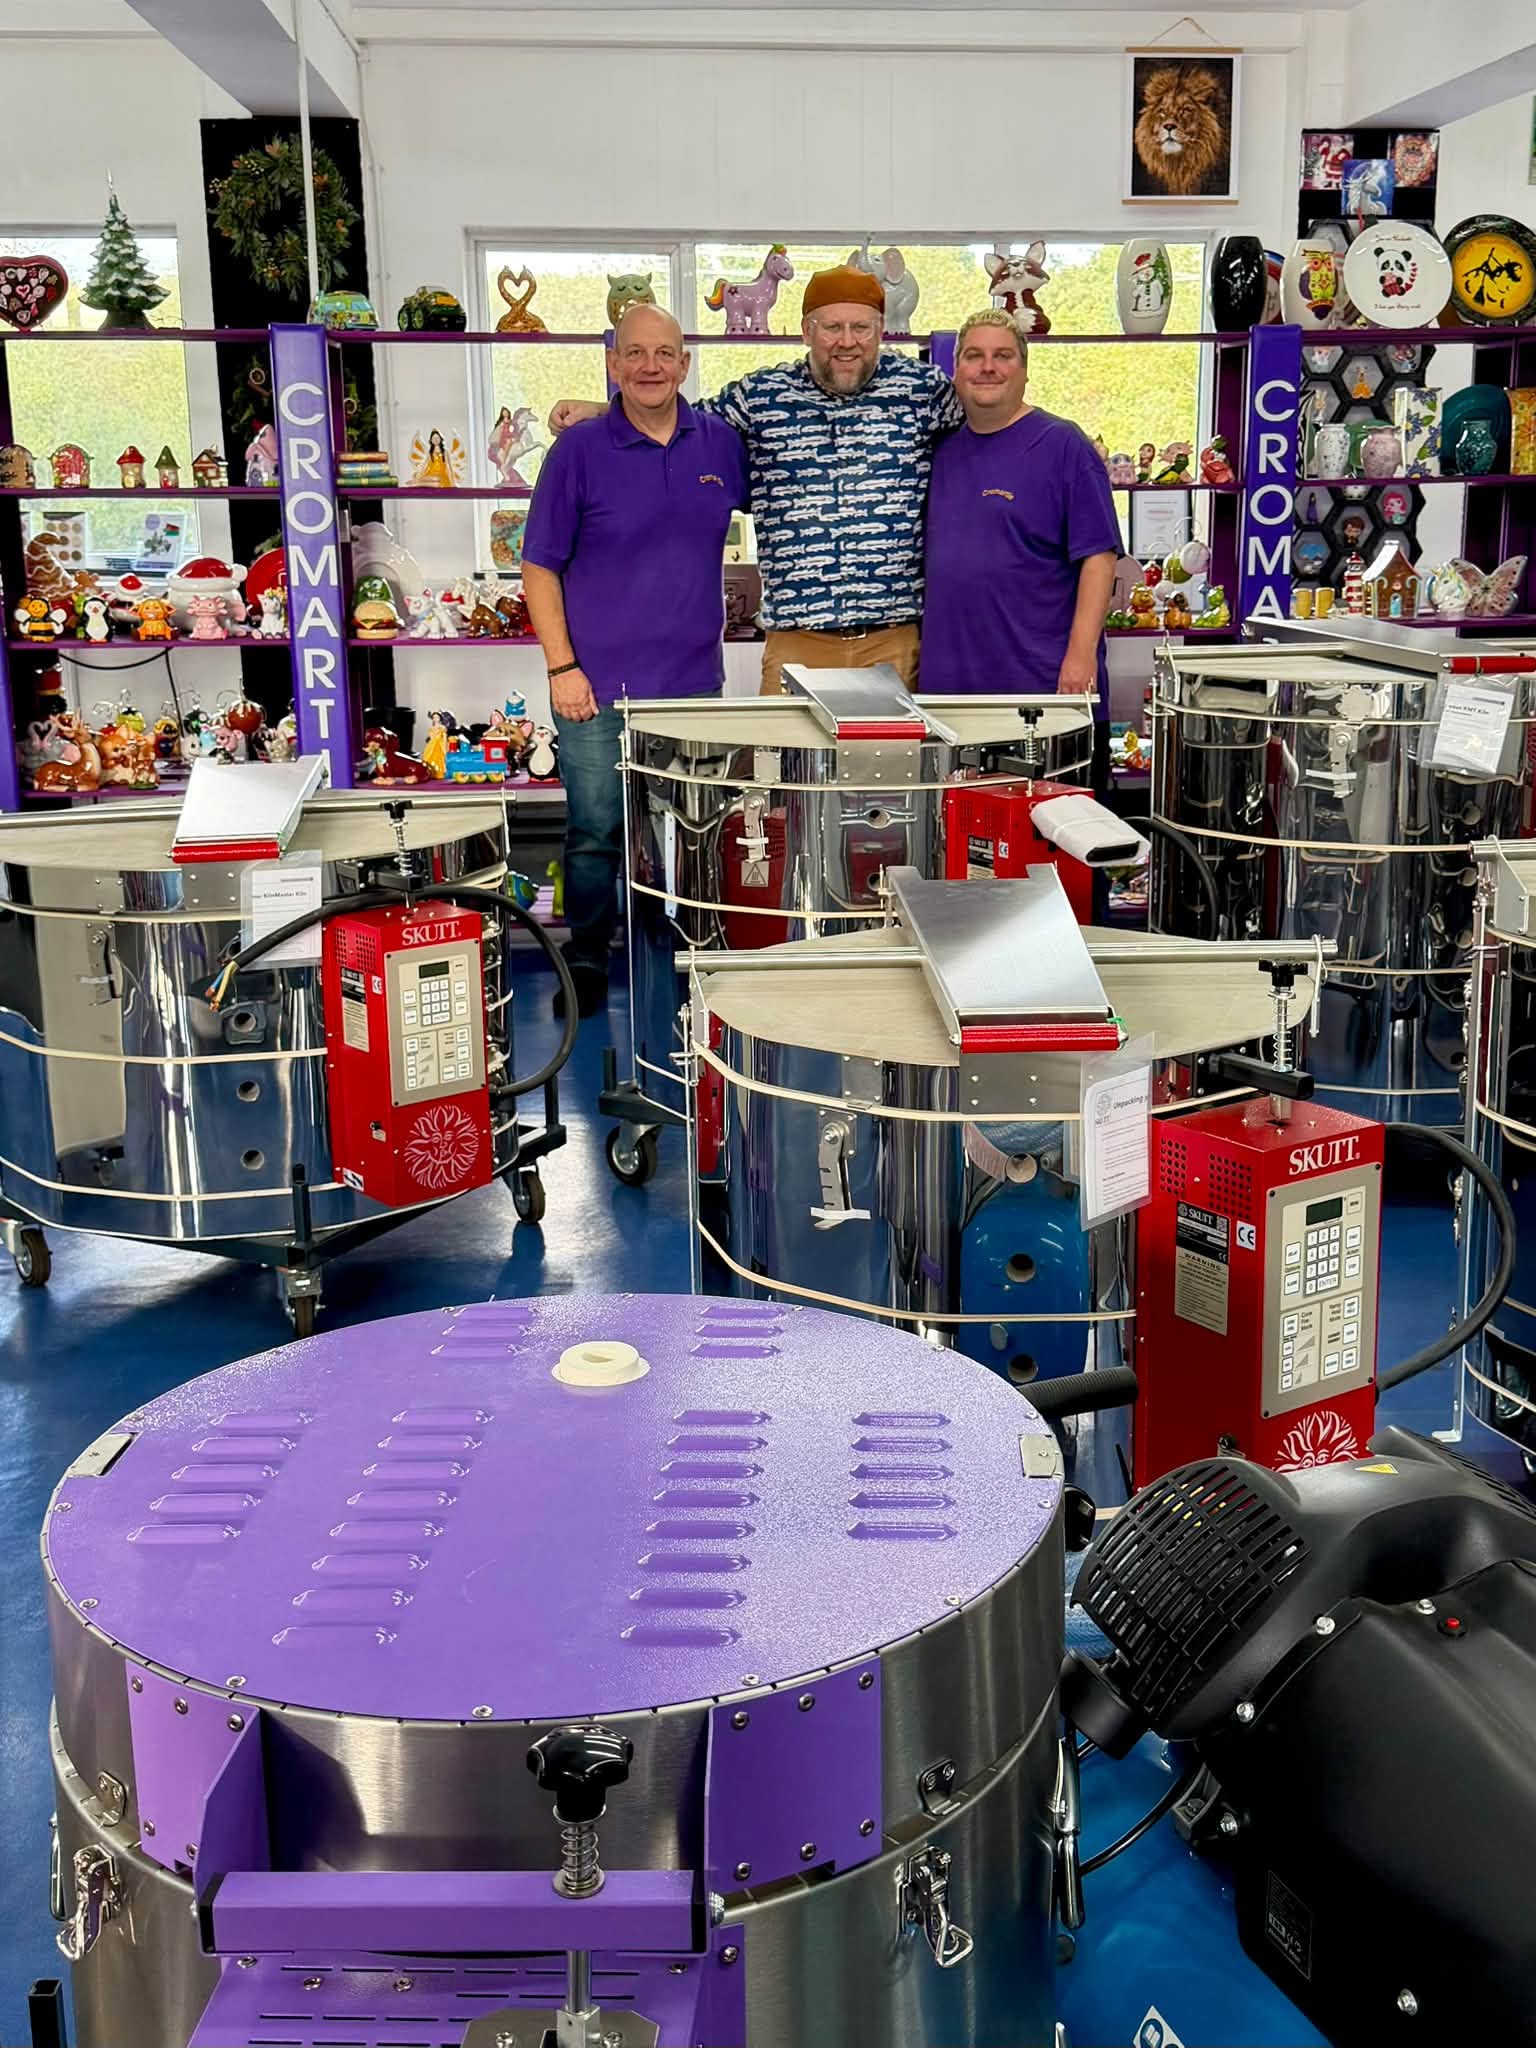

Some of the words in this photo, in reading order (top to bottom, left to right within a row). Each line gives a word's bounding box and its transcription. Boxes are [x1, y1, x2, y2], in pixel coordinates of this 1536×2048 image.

[401, 920, 460, 946] SKUTT
[1113, 1095, 1144, 1110] Unpacking
[1289, 1135, 1359, 1175] SKUTT
[1188, 1208, 1214, 1225] SKUTT
[1184, 1253, 1222, 1271] WARNING
